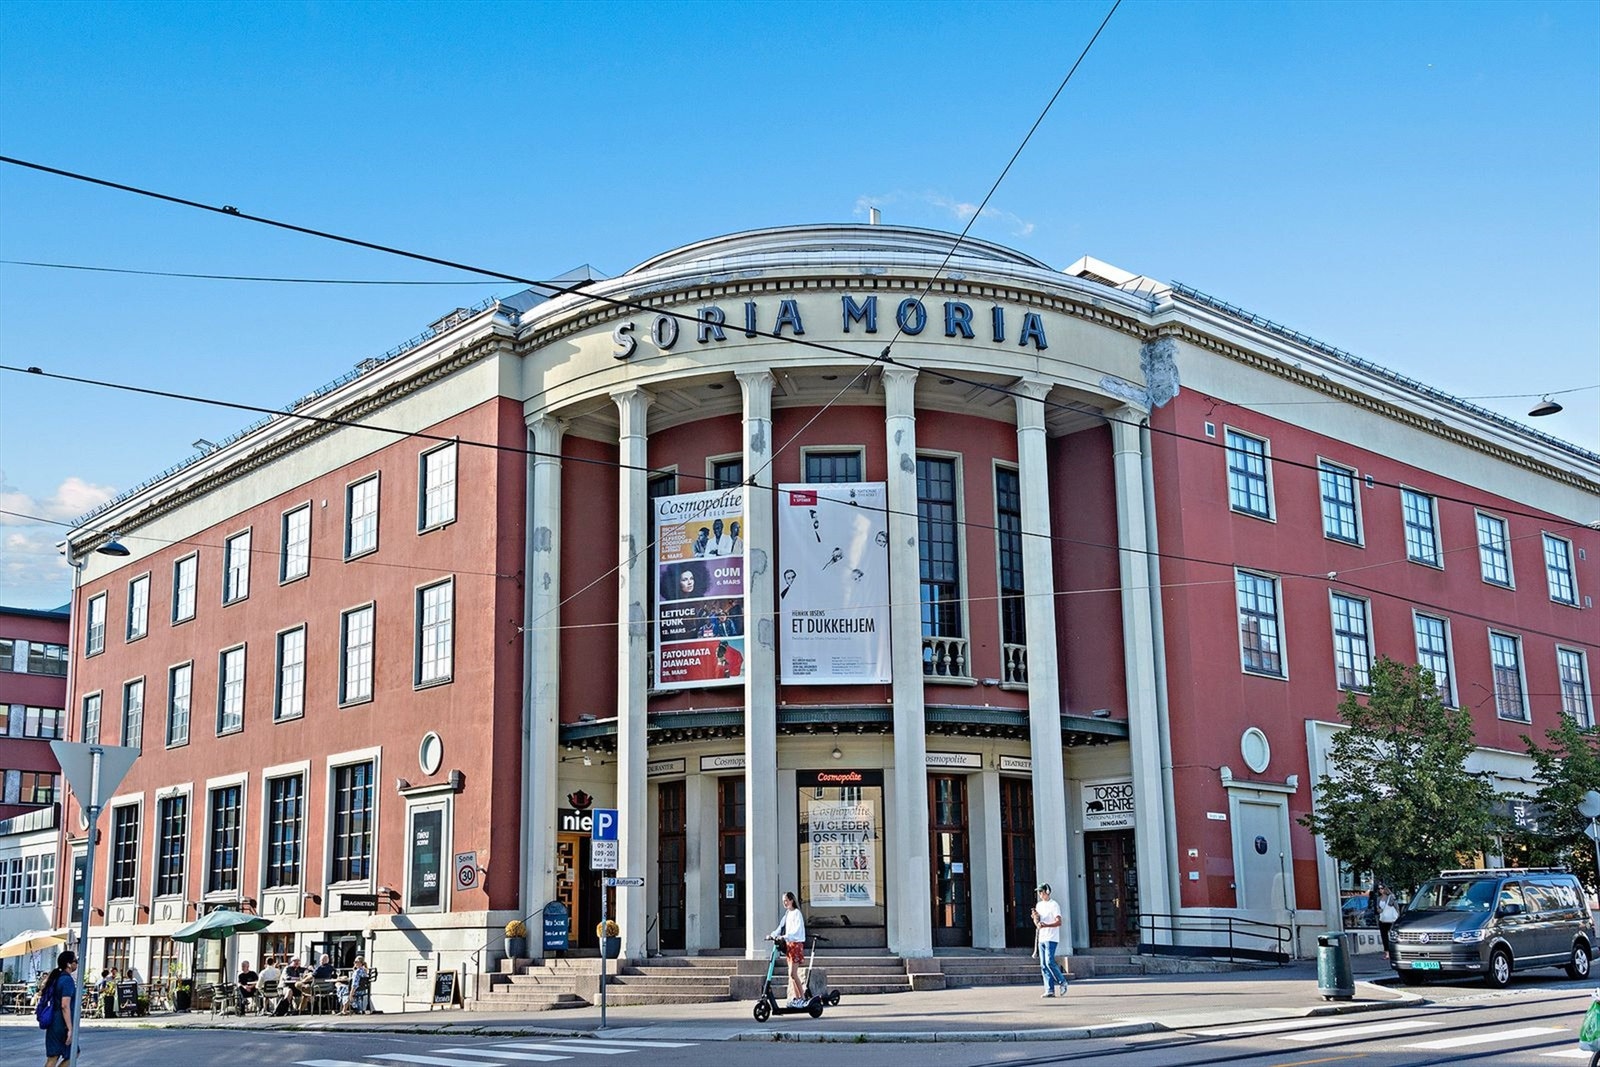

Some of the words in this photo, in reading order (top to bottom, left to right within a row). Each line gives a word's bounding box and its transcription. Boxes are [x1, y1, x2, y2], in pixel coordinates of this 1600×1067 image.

[612, 299, 806, 361] SORIA
[660, 491, 742, 517] Cosmopolite
[714, 568, 740, 578] OUM
[661, 608, 696, 618] LETTUCE
[661, 618, 684, 627] FUNK
[792, 618, 804, 633] ET
[807, 618, 875, 633] DUKKEHJEM
[662, 648, 711, 659] FATOUMATA
[662, 658, 701, 668] DIAWARA
[817, 771, 862, 784] Cosmopolite
[1094, 784, 1133, 799] TORSHO
[1102, 797, 1134, 811] TEATRE
[812, 806, 870, 817] Cosmopolite
[563, 809, 592, 831] nie
[598, 813, 613, 837] P
[813, 821, 824, 830] VI
[827, 821, 870, 830] GLEDER
[813, 833, 837, 843] OSS
[841, 833, 857, 843] TIL
[817, 846, 832, 855] SE
[835, 846, 866, 855] DERE
[458, 855, 473, 863] Sone
[462, 870, 472, 881] 30
[815, 871, 841, 880] MED
[844, 871, 869, 880] MER
[819, 883, 866, 893] MUSIKK
